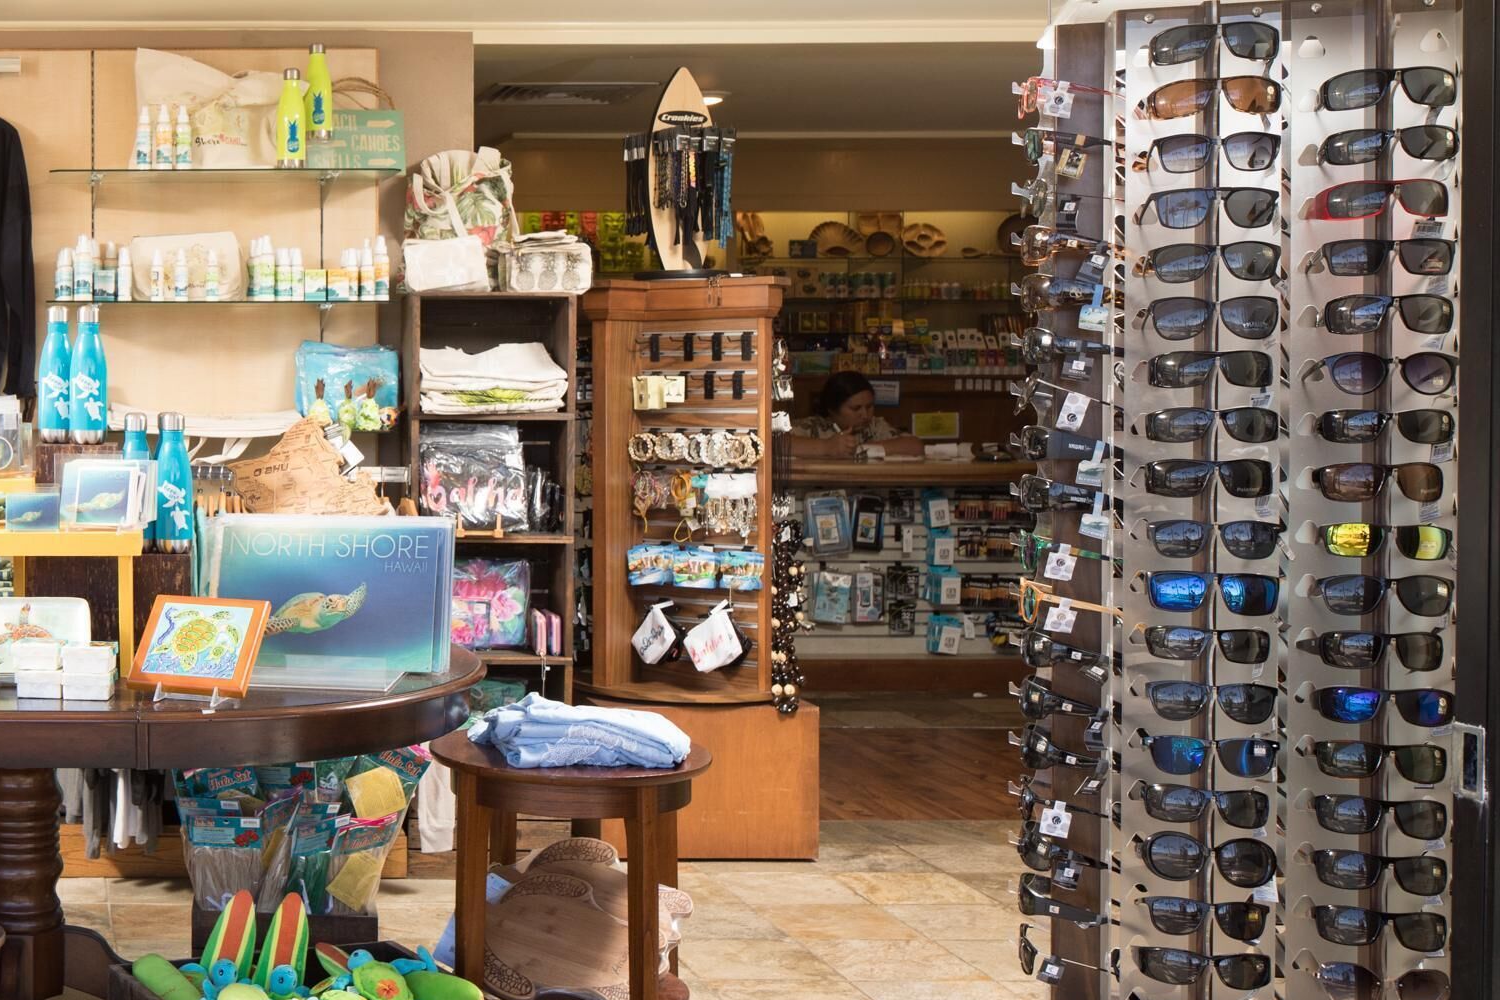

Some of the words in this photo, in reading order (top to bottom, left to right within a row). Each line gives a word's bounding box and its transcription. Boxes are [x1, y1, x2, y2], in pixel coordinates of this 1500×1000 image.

[351, 134, 400, 152] CANOES
[229, 533, 325, 557] NORTH
[335, 534, 429, 559] SHORE
[384, 561, 428, 573] HAWAII
[209, 776, 234, 790] Hula
[234, 769, 253, 783] Set
